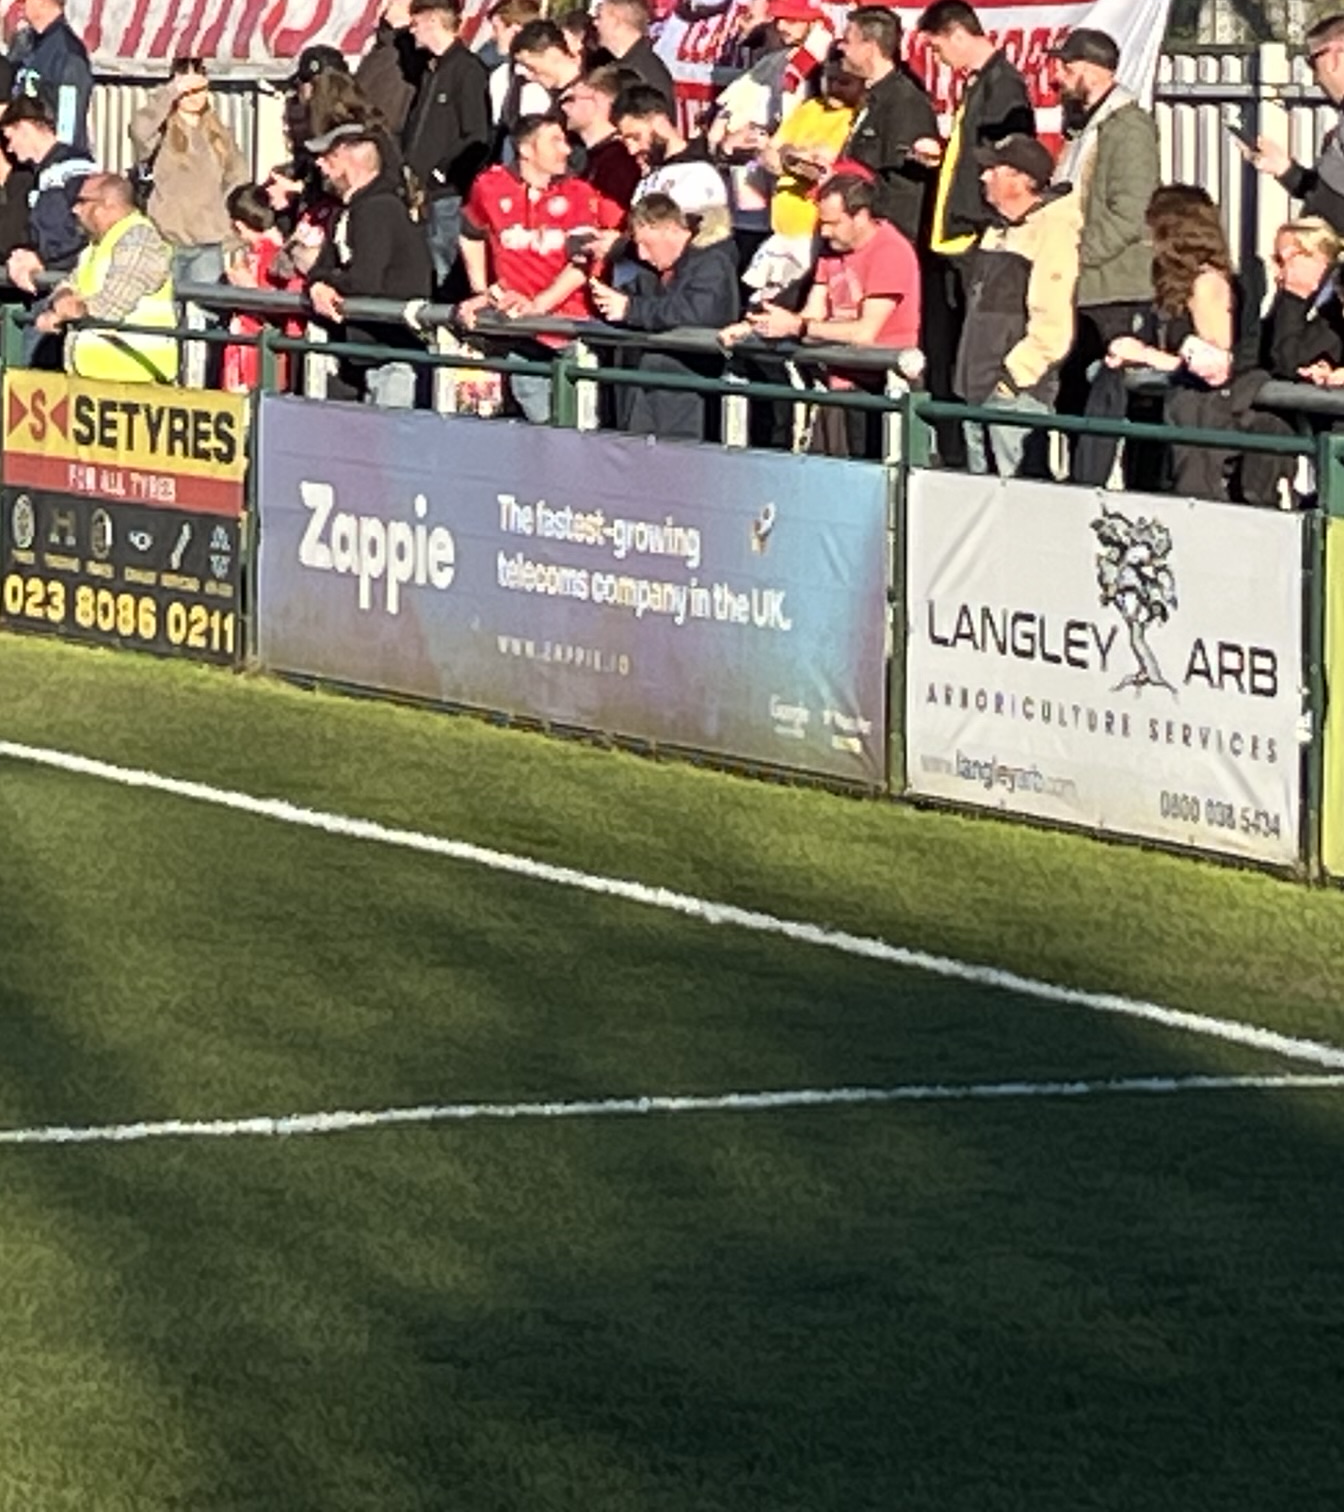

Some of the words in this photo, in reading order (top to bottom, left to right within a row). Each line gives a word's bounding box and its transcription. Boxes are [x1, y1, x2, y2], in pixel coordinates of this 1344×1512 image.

[72, 393, 237, 465] SETYRES
[298, 479, 455, 615] Zappie
[497, 493, 535, 535] The
[536, 500, 702, 569] fastest-growing
[4, 573, 66, 623] 023
[74, 585, 158, 640] 8086
[166, 601, 235, 655] 0211
[496, 550, 590, 601] telecoms
[591, 570, 688, 626] company
[689, 576, 712, 619] in
[713, 582, 751, 624] the
[752, 588, 793, 632] UK.
[926, 598, 1118, 672] LANGLEY
[1183, 637, 1279, 698] ARB
[925, 682, 1132, 739] ARBORICULTURE
[1147, 717, 1280, 764] SERVICES
